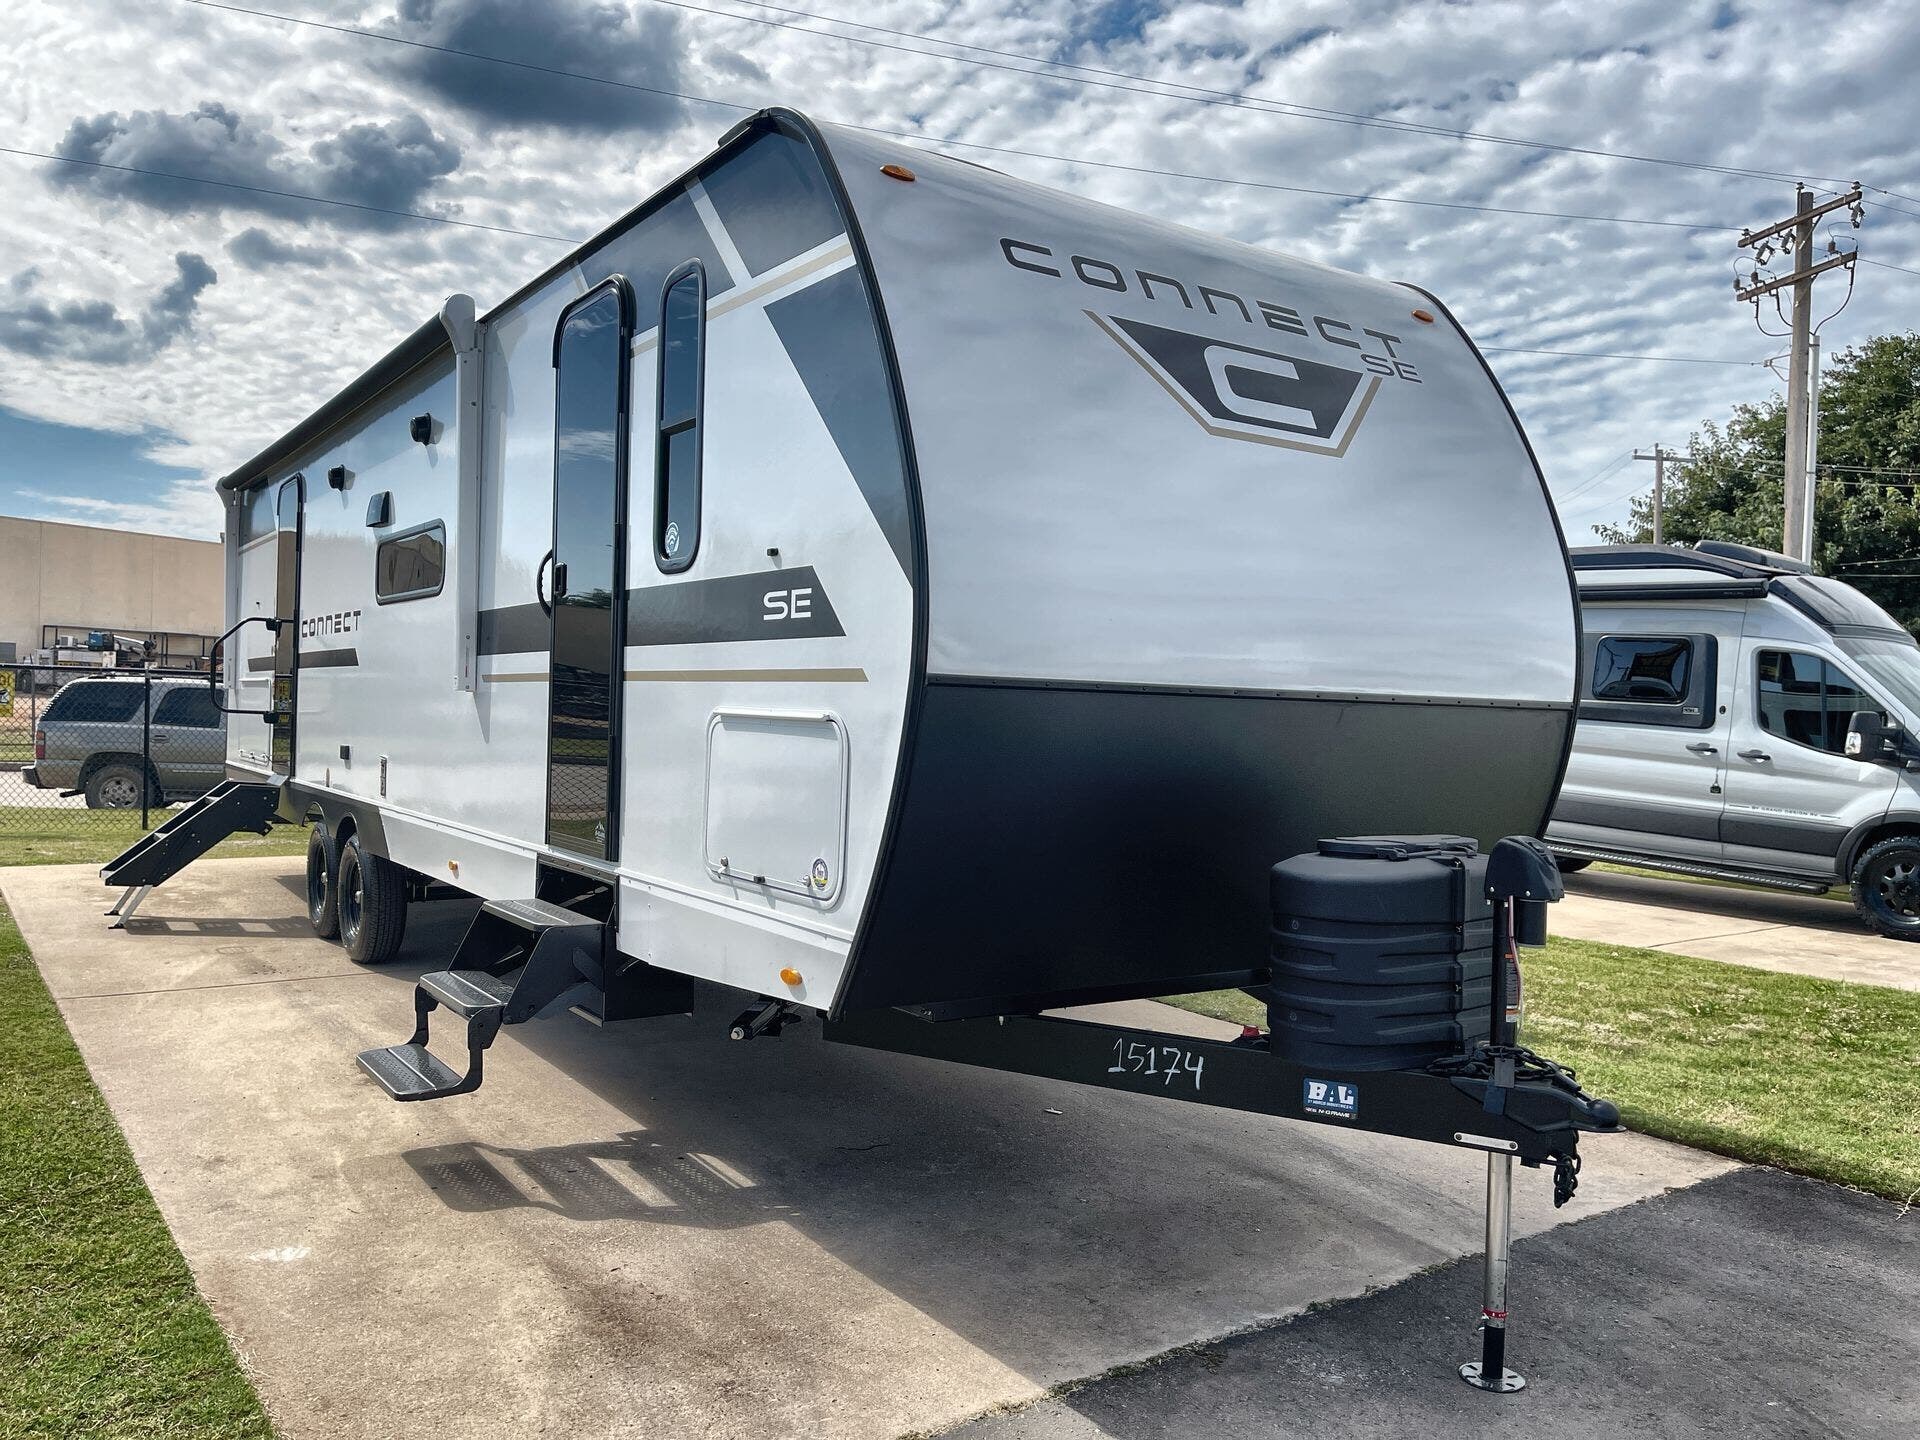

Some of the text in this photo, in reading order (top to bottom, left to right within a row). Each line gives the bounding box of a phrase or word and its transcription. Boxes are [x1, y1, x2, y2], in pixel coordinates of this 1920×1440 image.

[999, 237, 1402, 358] CONNECT
[1360, 353, 1423, 384] SE
[762, 587, 812, 622] SE
[301, 610, 362, 638] CONNECT
[1107, 1038, 1205, 1090] 15174
[1308, 1081, 1354, 1105] BAL
